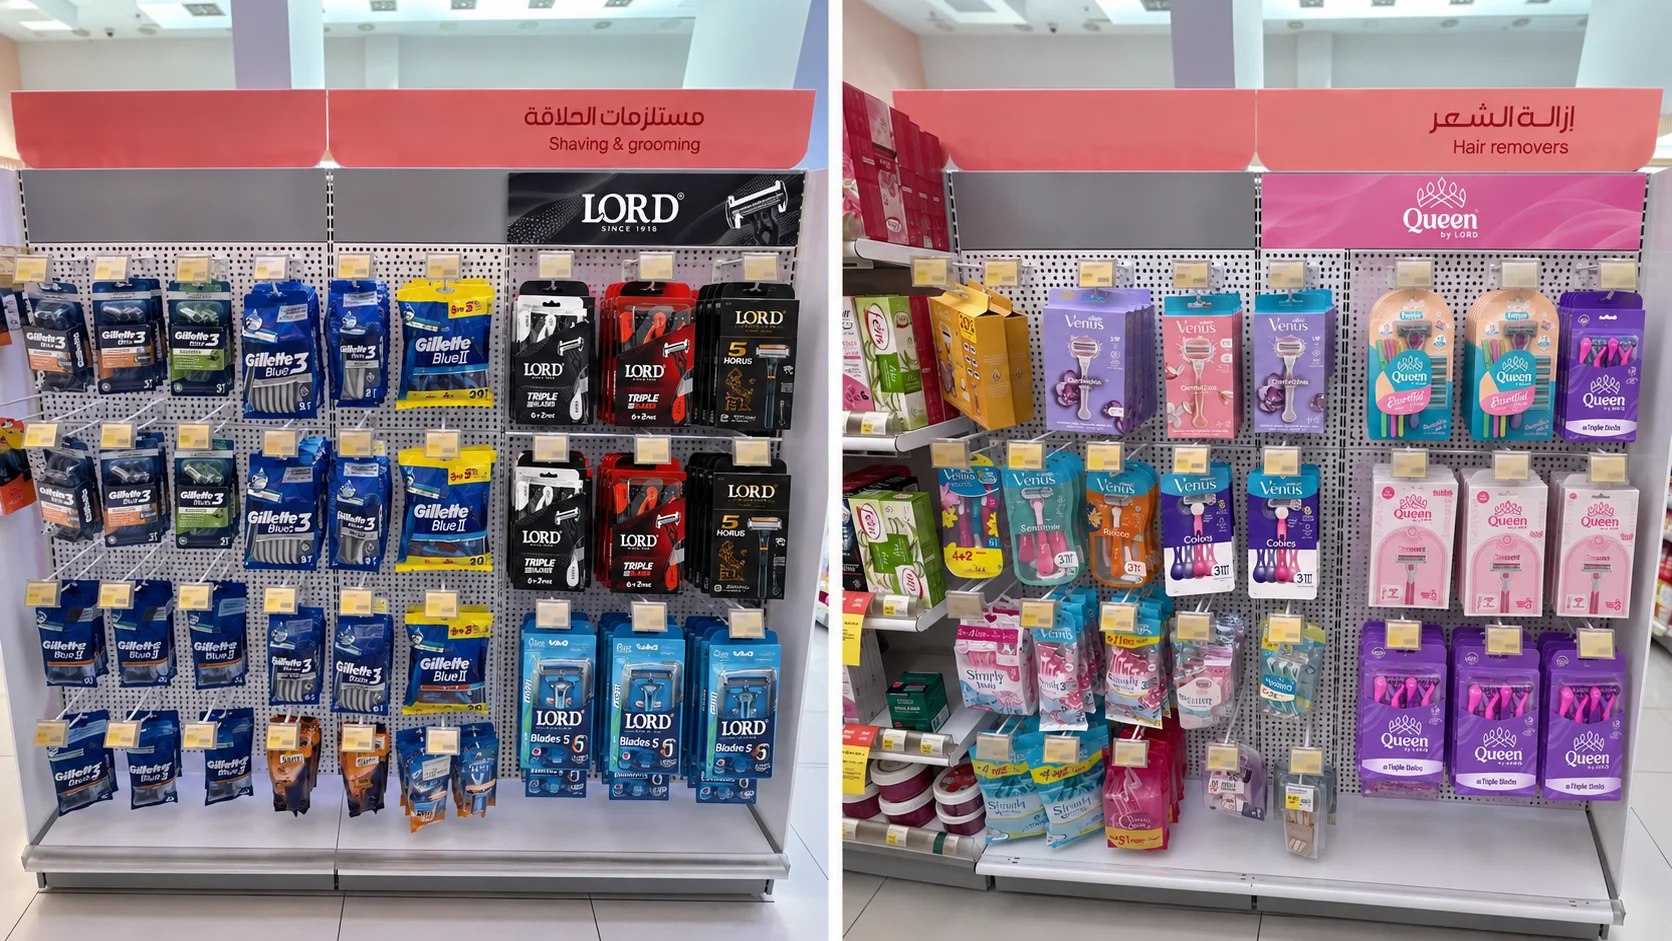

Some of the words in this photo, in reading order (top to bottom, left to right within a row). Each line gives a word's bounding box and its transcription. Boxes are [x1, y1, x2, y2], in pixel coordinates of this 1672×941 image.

[524, 106, 597, 126] الحلاقة
[600, 106, 704, 131] مستلزمات
[1429, 103, 1513, 134] الشعر
[1517, 105, 1575, 133] إزالة
[549, 137, 608, 154] Shaving
[612, 137, 624, 151] &
[628, 138, 701, 154] grooming
[1453, 139, 1486, 154] Hair
[1490, 142, 1569, 154] removers
[581, 193, 680, 224] LORD
[1403, 207, 1478, 233] Queen
[1440, 231, 1451, 240] by
[1454, 231, 1478, 239] LORD
[735, 310, 783, 325] LORD
[1065, 314, 1104, 330] Venus
[1269, 317, 1308, 332] Venus
[1176, 320, 1216, 334] Venus
[415, 336, 471, 352] Gillette
[728, 341, 747, 357] 5
[245, 352, 293, 368] Gillette
[289, 352, 309, 375] 3
[723, 357, 752, 365] HORUS
[265, 366, 290, 378] Blue
[524, 362, 563, 376] LORD
[625, 364, 665, 378] LORD
[1392, 371, 1428, 384] Queen
[1496, 371, 1532, 384] Queen
[527, 392, 558, 401] TRIPLE
[628, 393, 660, 403] TRIPLE
[1583, 392, 1625, 408] Queen
[1013, 473, 1056, 486] Venus
[1096, 478, 1136, 494] Venus
[1174, 478, 1217, 493] Venus
[727, 484, 776, 498] LORD
[1260, 480, 1303, 495] Venus
[413, 503, 469, 519] Gillette
[1393, 509, 1432, 522] Queen
[247, 511, 298, 524] Gillette
[296, 512, 312, 532] 3
[363, 517, 376, 531] 3
[431, 520, 457, 532] Blue
[721, 514, 740, 529] 5
[1488, 515, 1528, 528] Queen
[1580, 516, 1619, 528] Queen
[522, 530, 561, 544] LORD
[620, 534, 658, 547] LORD
[716, 529, 746, 537] HORUS
[524, 558, 556, 567] TRIPLE
[952, 550, 973, 561] 4+2
[623, 561, 654, 570] TRIPLE
[420, 657, 470, 670] Gillette
[433, 670, 458, 682] Blue
[536, 710, 583, 726] LORD
[625, 713, 671, 730] LORD
[721, 720, 766, 736] LORD
[530, 734, 561, 743] Blades
[1381, 732, 1429, 749] Queen
[1475, 746, 1523, 763] Queen
[1565, 750, 1610, 767] Queen
